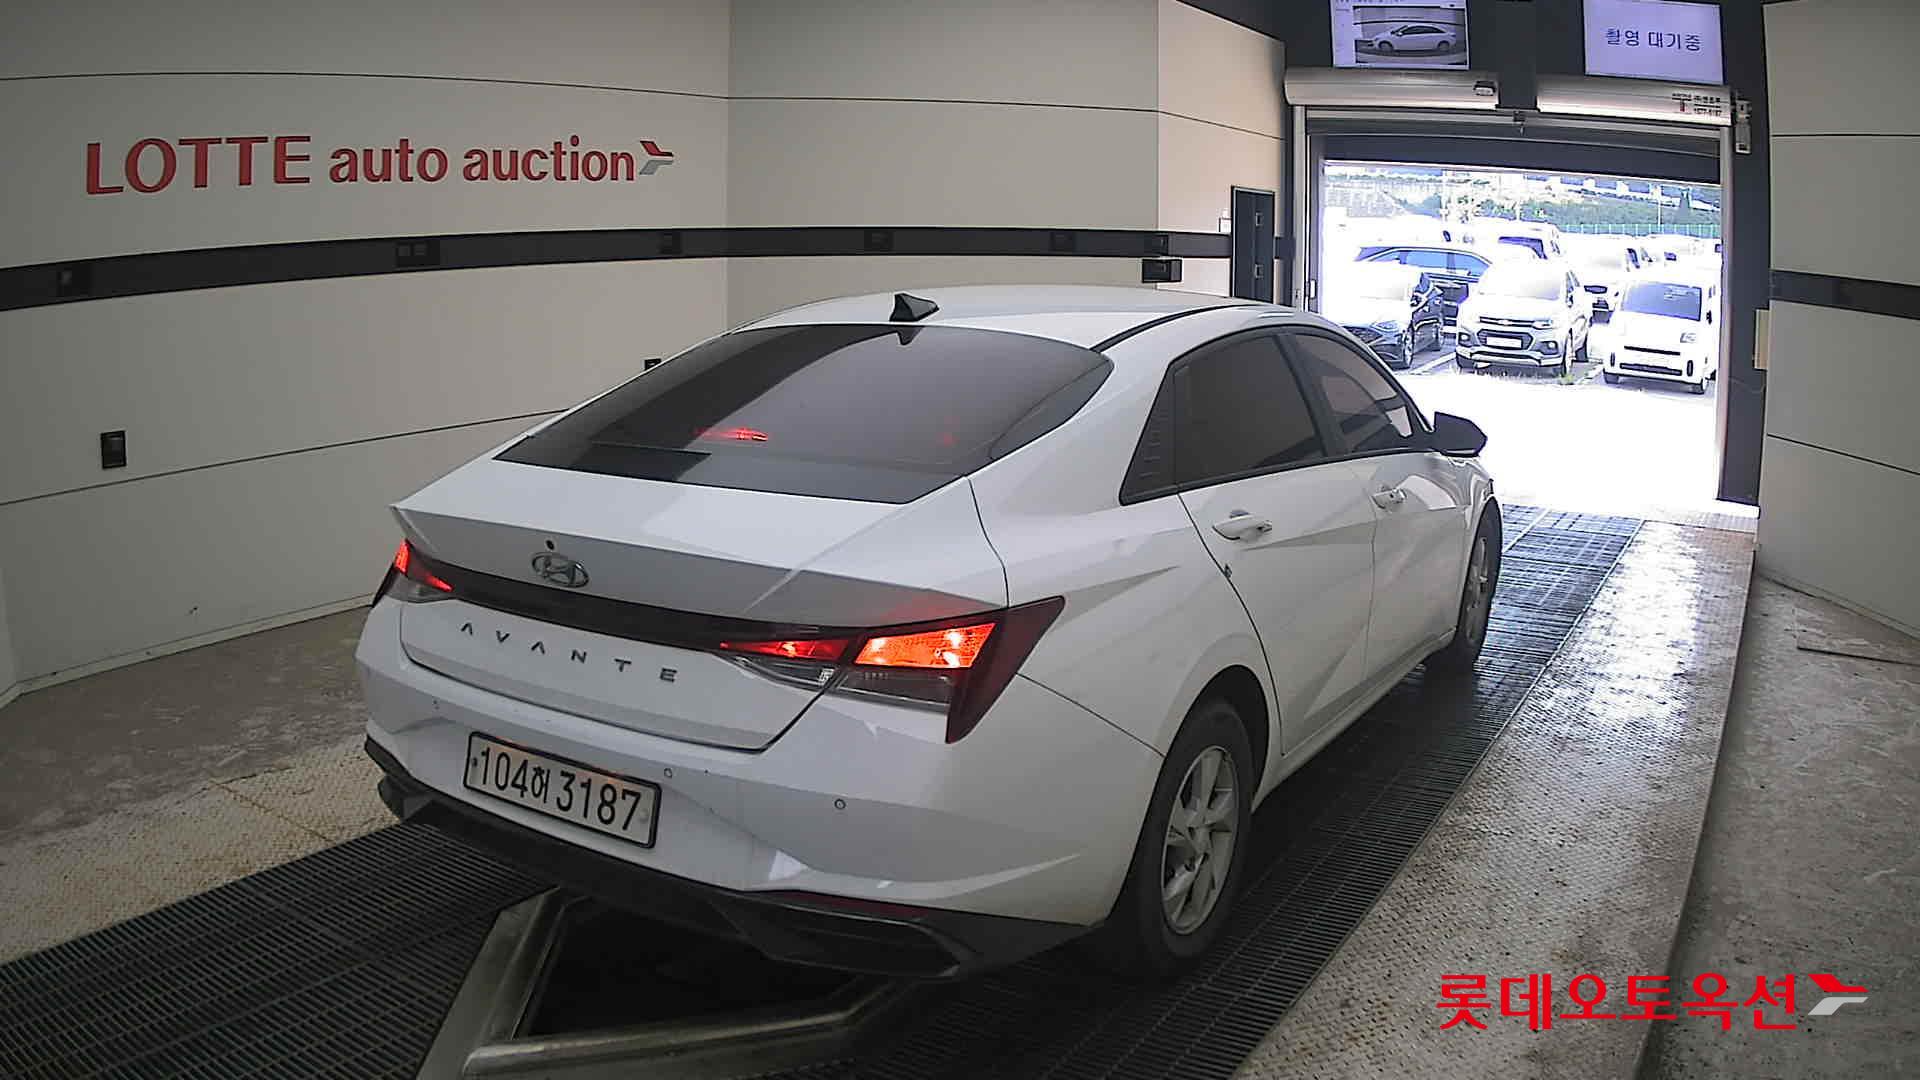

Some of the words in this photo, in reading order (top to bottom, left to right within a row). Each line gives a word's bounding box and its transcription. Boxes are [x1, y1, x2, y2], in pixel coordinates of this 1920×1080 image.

[1648, 31, 1701, 52] 대기중
[86, 136, 311, 195] LOTTE
[329, 138, 449, 183] auto
[463, 135, 635, 181] auction
[460, 622, 678, 683] AVANTE
